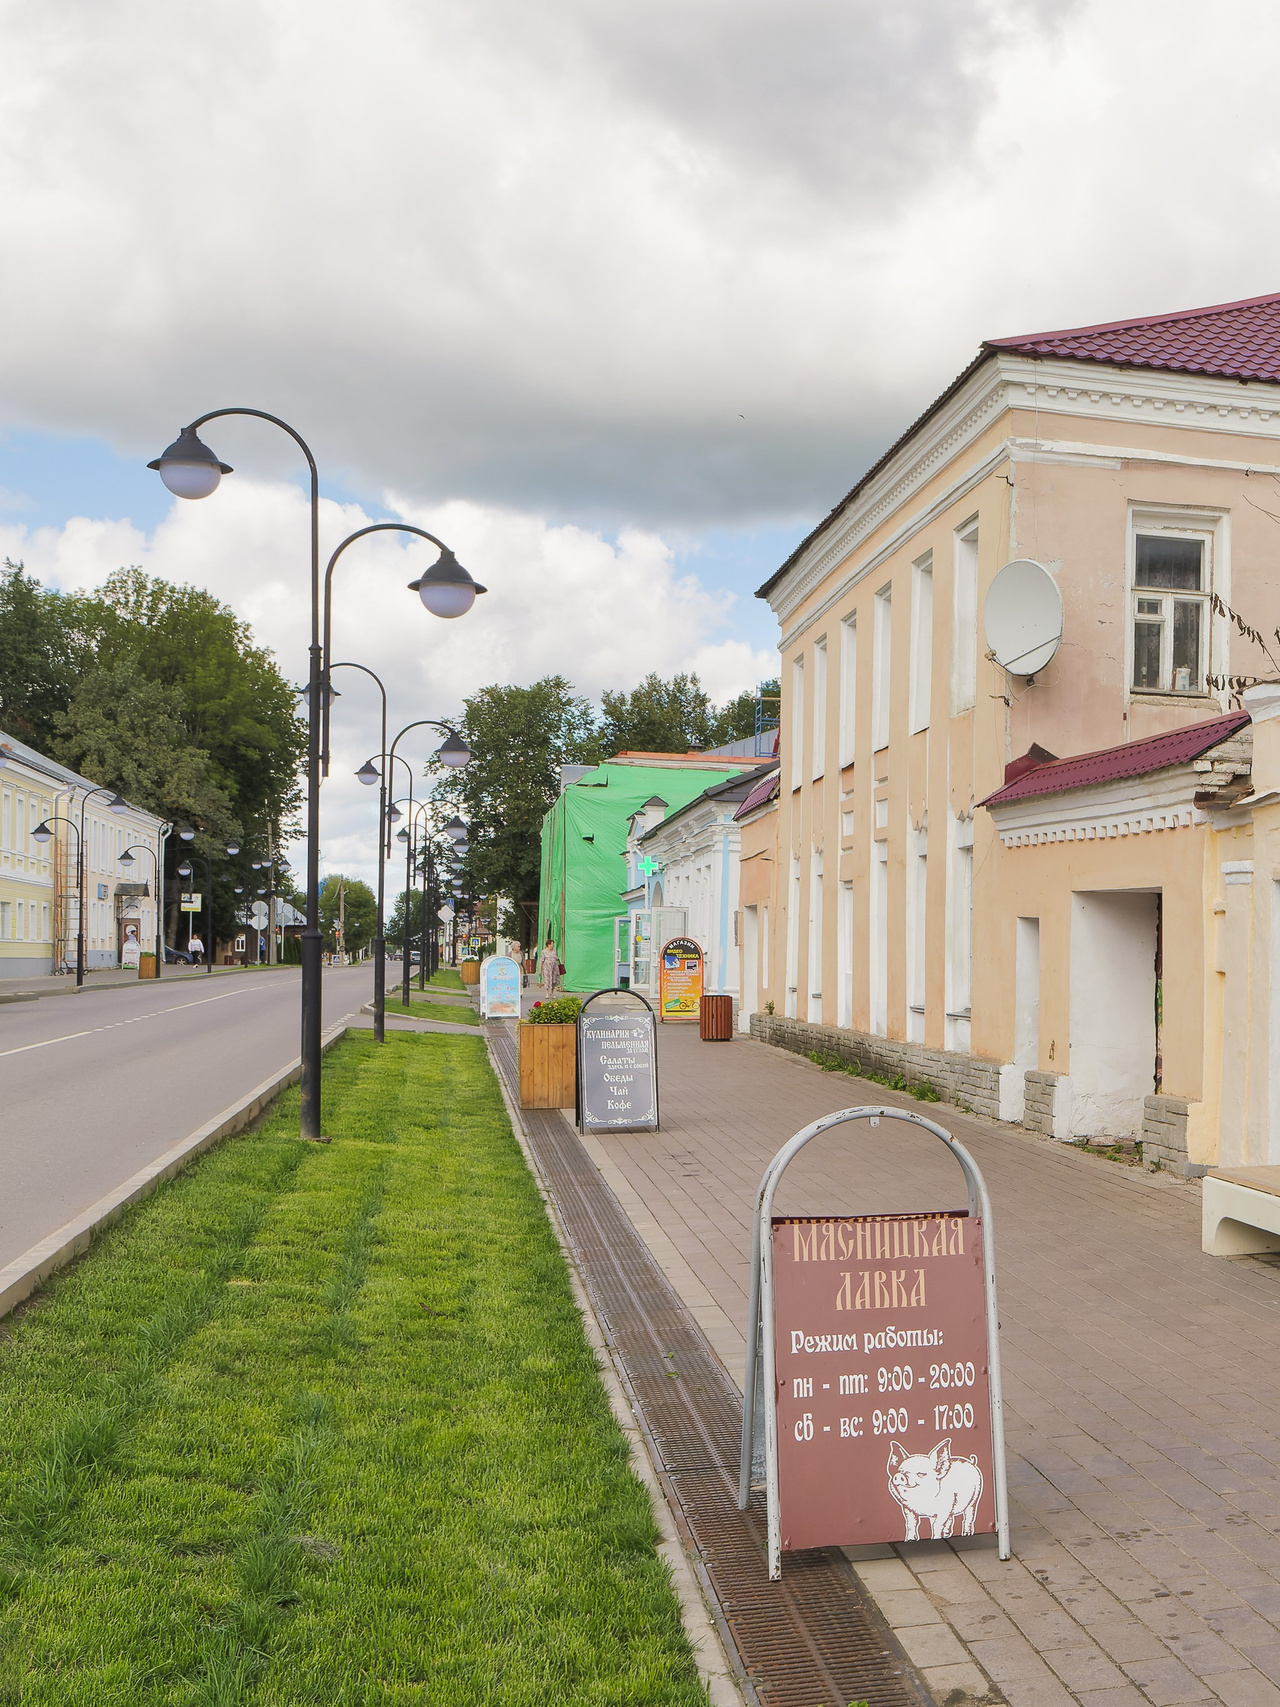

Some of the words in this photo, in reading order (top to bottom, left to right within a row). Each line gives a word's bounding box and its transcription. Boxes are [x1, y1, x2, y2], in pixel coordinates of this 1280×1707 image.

[586, 1030, 630, 1041] КУЛИНАРИЯ
[601, 1040, 649, 1049] ПЕЛЬМЕННАЯ
[609, 1086, 628, 1096] Чай
[607, 1100, 632, 1111] Кофе
[792, 1218, 966, 1262] МЯСНИЦКАЯ
[835, 1268, 928, 1311] ЛАВКА
[790, 1329, 858, 1354] Режим
[863, 1326, 943, 1354] работы:
[793, 1376, 813, 1398] пн
[839, 1374, 868, 1395] пт:
[877, 1364, 913, 1394] 9:00
[929, 1361, 975, 1390] 20:00
[794, 1412, 814, 1442] сб
[840, 1416, 864, 1438] вс:
[872, 1407, 908, 1436] 9:00
[934, 1402, 974, 1430] 17:00
